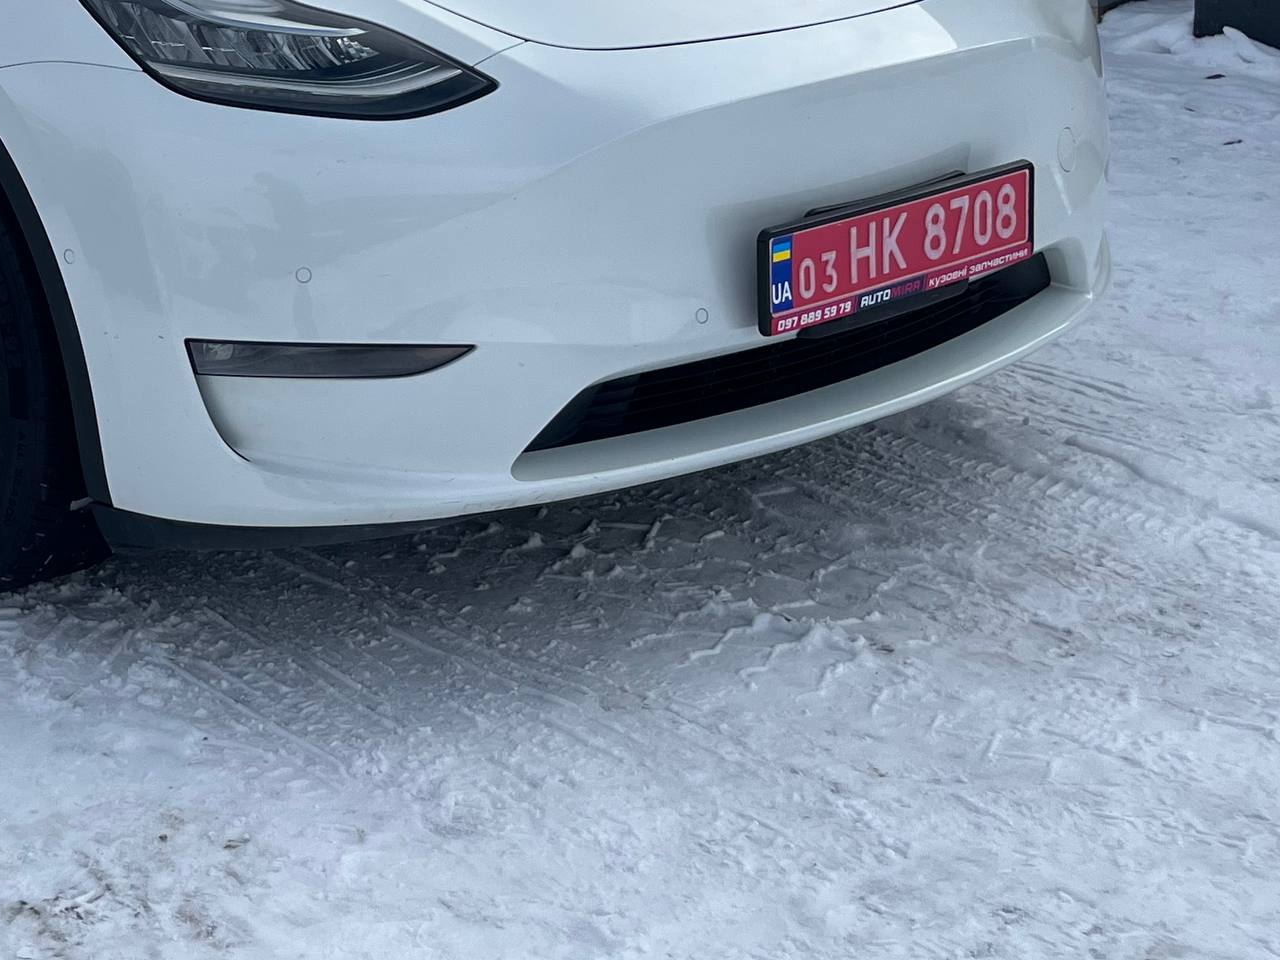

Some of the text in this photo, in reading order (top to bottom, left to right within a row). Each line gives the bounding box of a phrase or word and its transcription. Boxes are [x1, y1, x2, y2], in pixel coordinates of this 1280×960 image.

[799, 183, 1017, 299] 03 HK 8708
[969, 248, 1028, 275] запчастини
[772, 280, 792, 304] UA
[777, 316, 799, 331] 097
[823, 305, 838, 319] 59
[839, 301, 852, 314] 79
